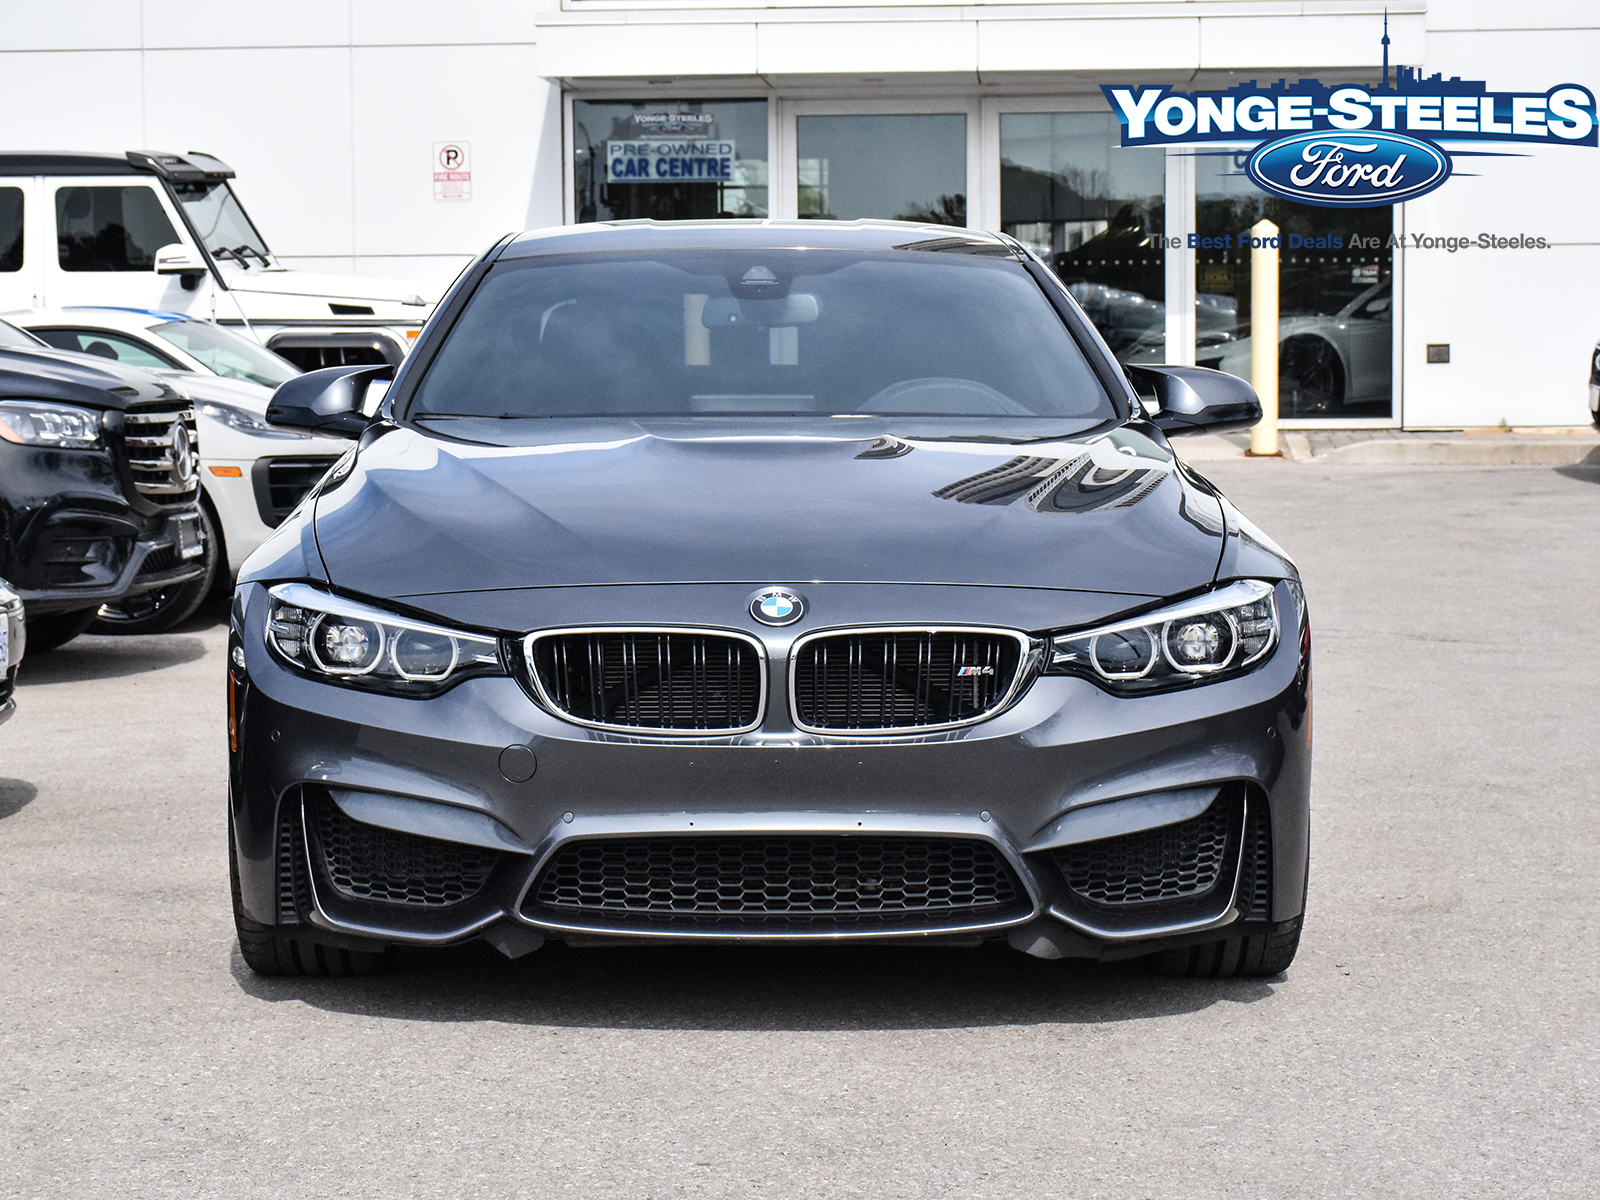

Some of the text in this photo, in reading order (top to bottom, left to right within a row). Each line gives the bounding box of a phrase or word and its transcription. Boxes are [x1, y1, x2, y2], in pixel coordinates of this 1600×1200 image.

[610, 144, 732, 155] PRE-OWNED
[612, 157, 731, 177] CAR CENTRE
